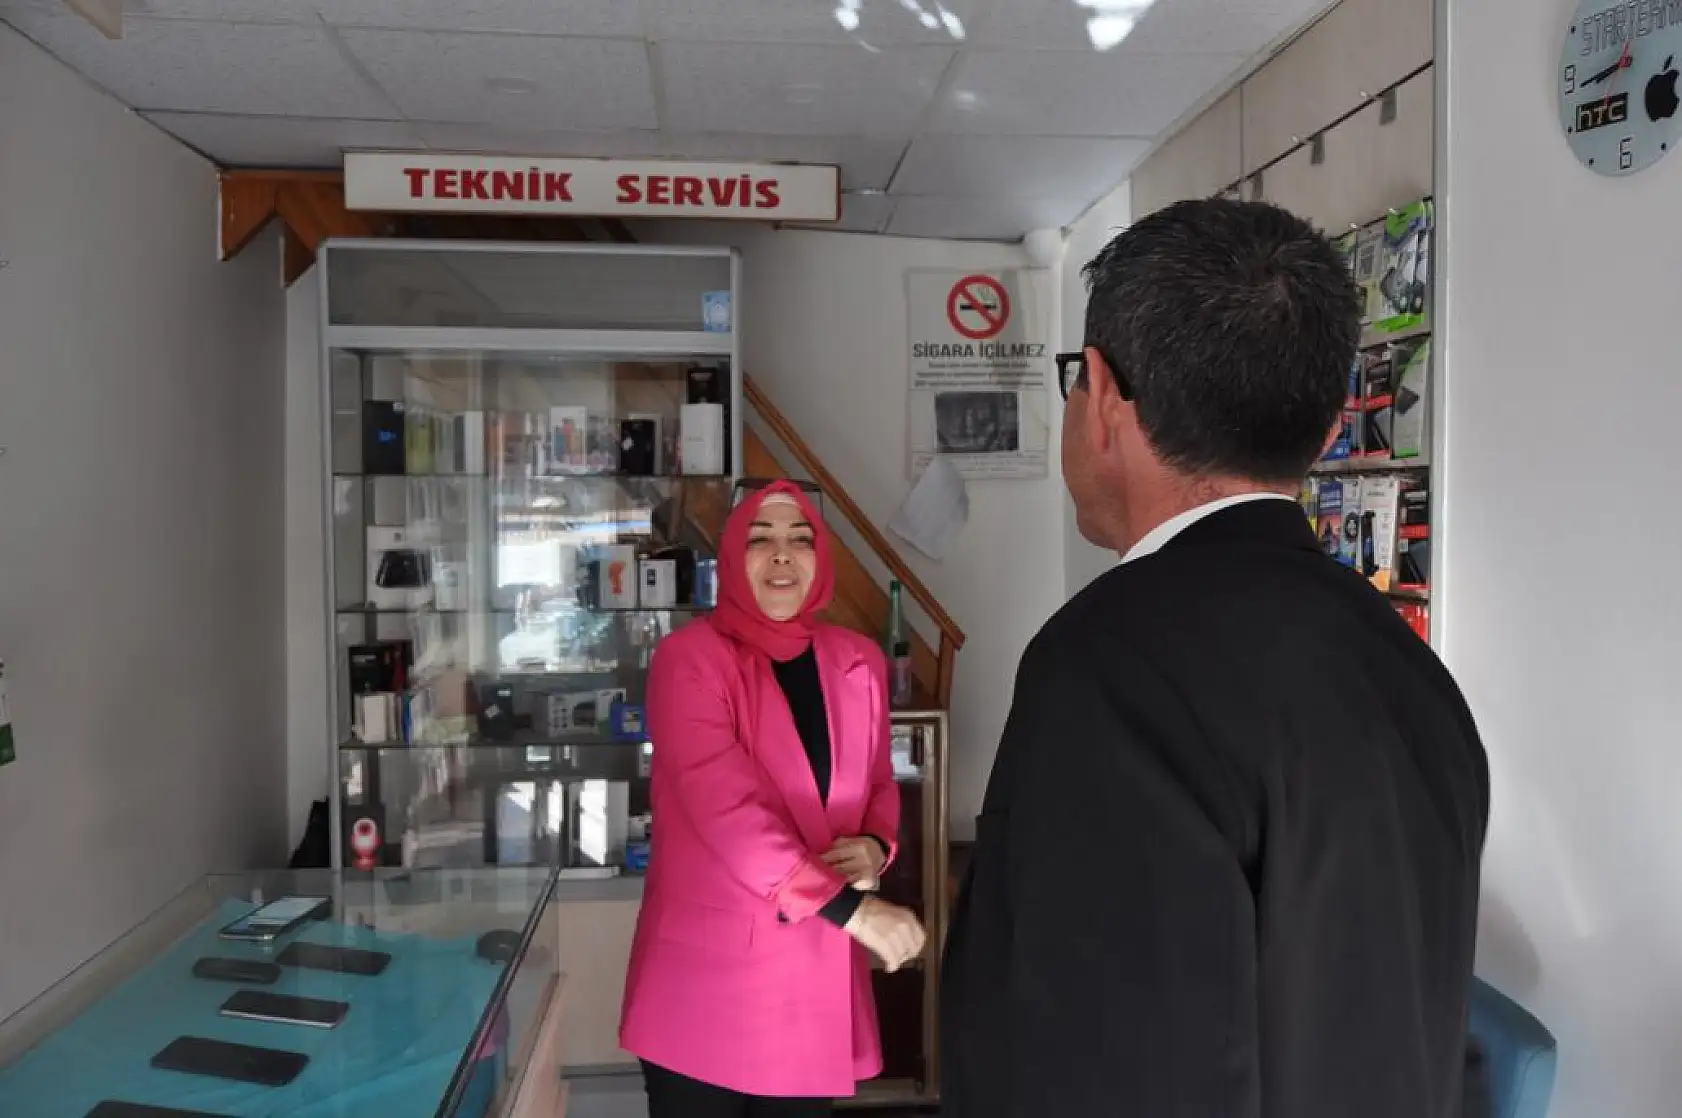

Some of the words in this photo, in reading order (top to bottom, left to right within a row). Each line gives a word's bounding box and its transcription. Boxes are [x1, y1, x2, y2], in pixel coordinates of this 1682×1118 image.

[1564, 64, 1576, 95] 9
[1577, 101, 1626, 131] htc
[1619, 137, 1632, 169] 6
[403, 165, 574, 202] TEKNİK
[615, 172, 780, 209] SERVİS
[912, 340, 974, 358] SİGARA
[979, 340, 1046, 360] İÇİLMEZ
